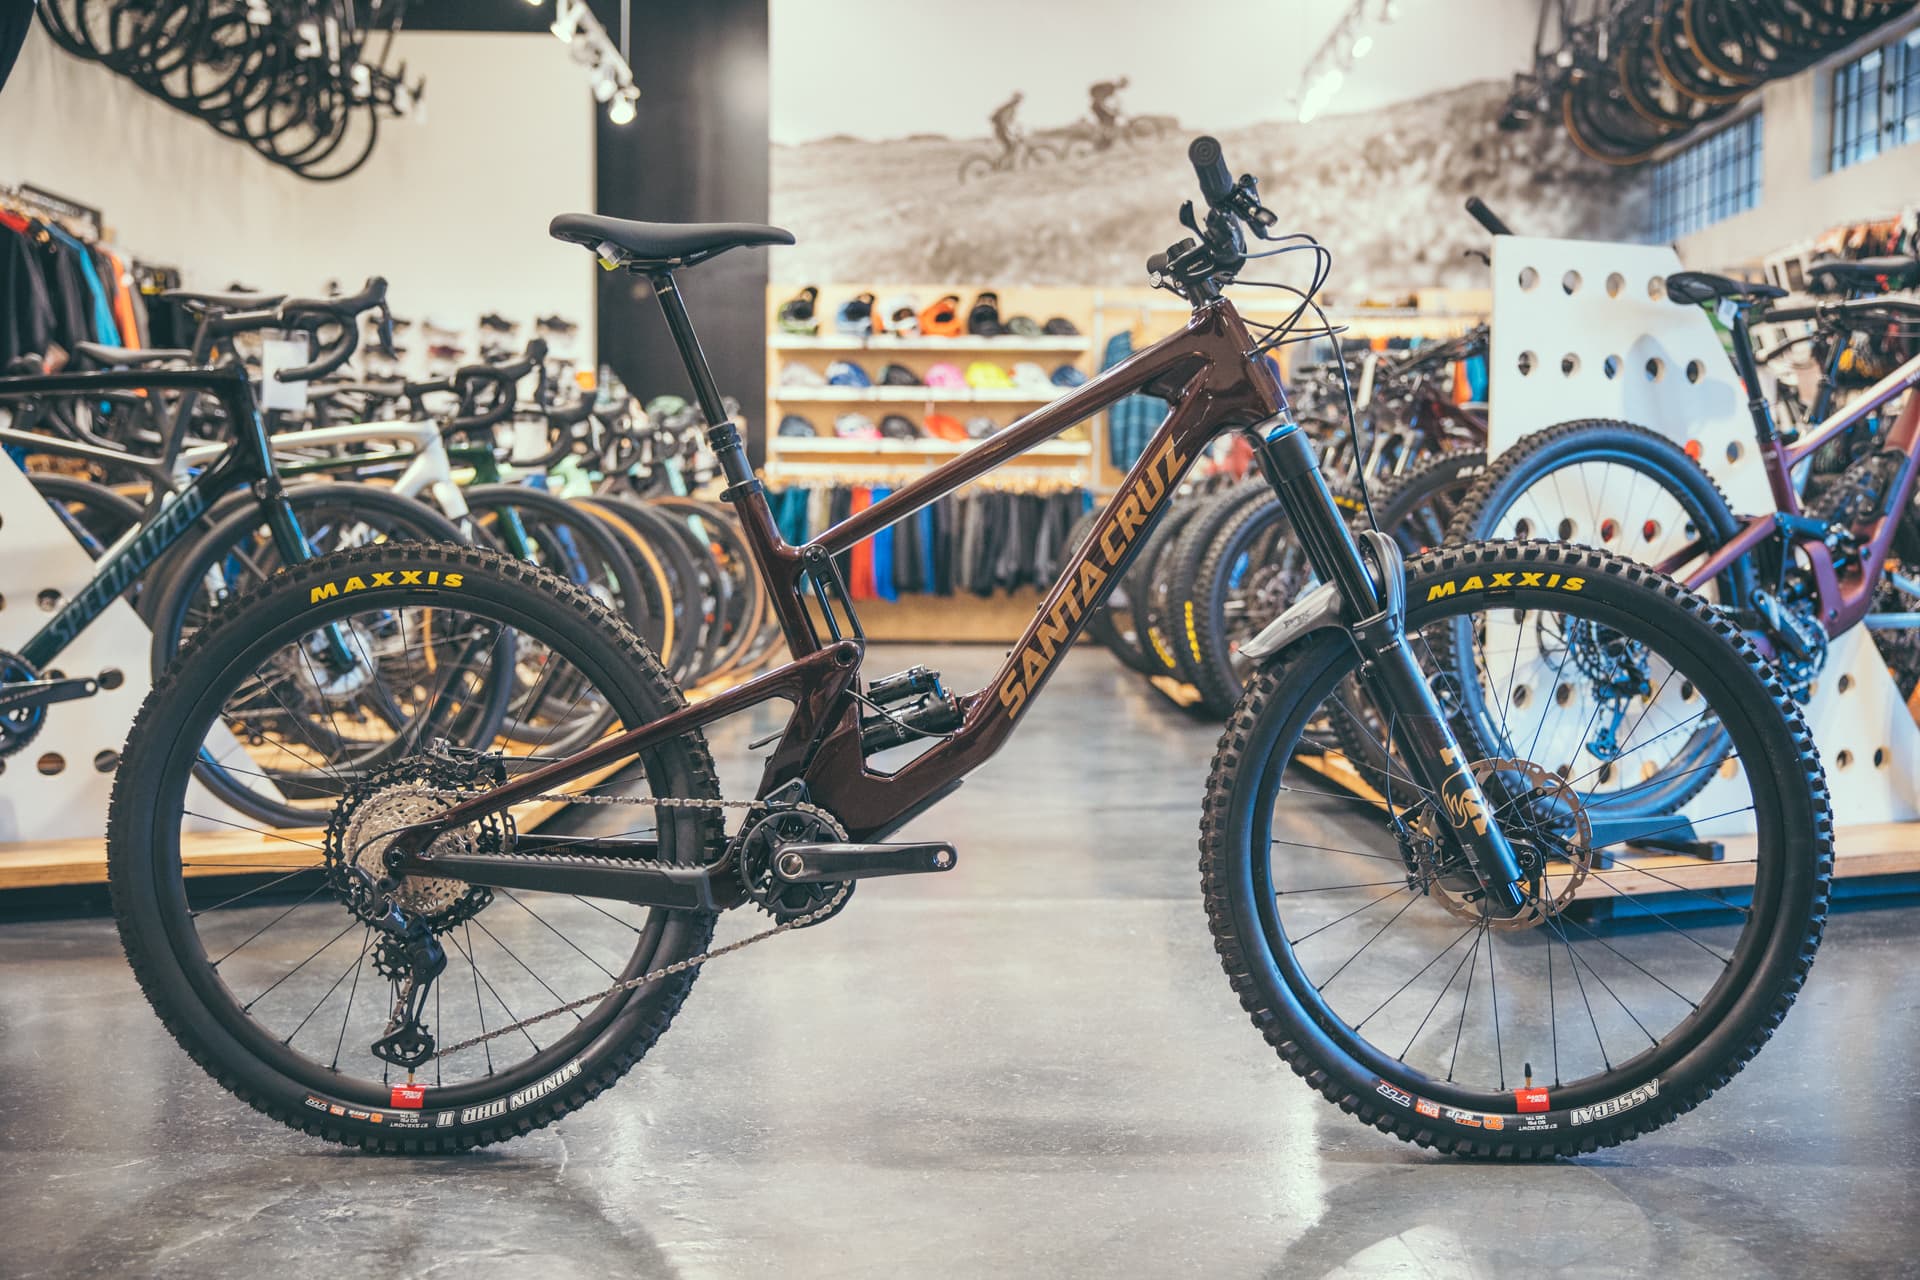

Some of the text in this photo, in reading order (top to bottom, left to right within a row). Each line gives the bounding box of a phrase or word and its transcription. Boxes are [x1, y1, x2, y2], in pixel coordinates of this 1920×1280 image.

[50, 485, 204, 644] SPECIALIZED
[310, 570, 464, 604] MAXXIS
[1000, 433, 1187, 719] SANTA CRUZ
[1426, 572, 1586, 602] MAXXIS
[510, 1058, 582, 1111] MINION
[1570, 1078, 1660, 1126] ASSEGAI
[461, 1098, 507, 1124] DHR
